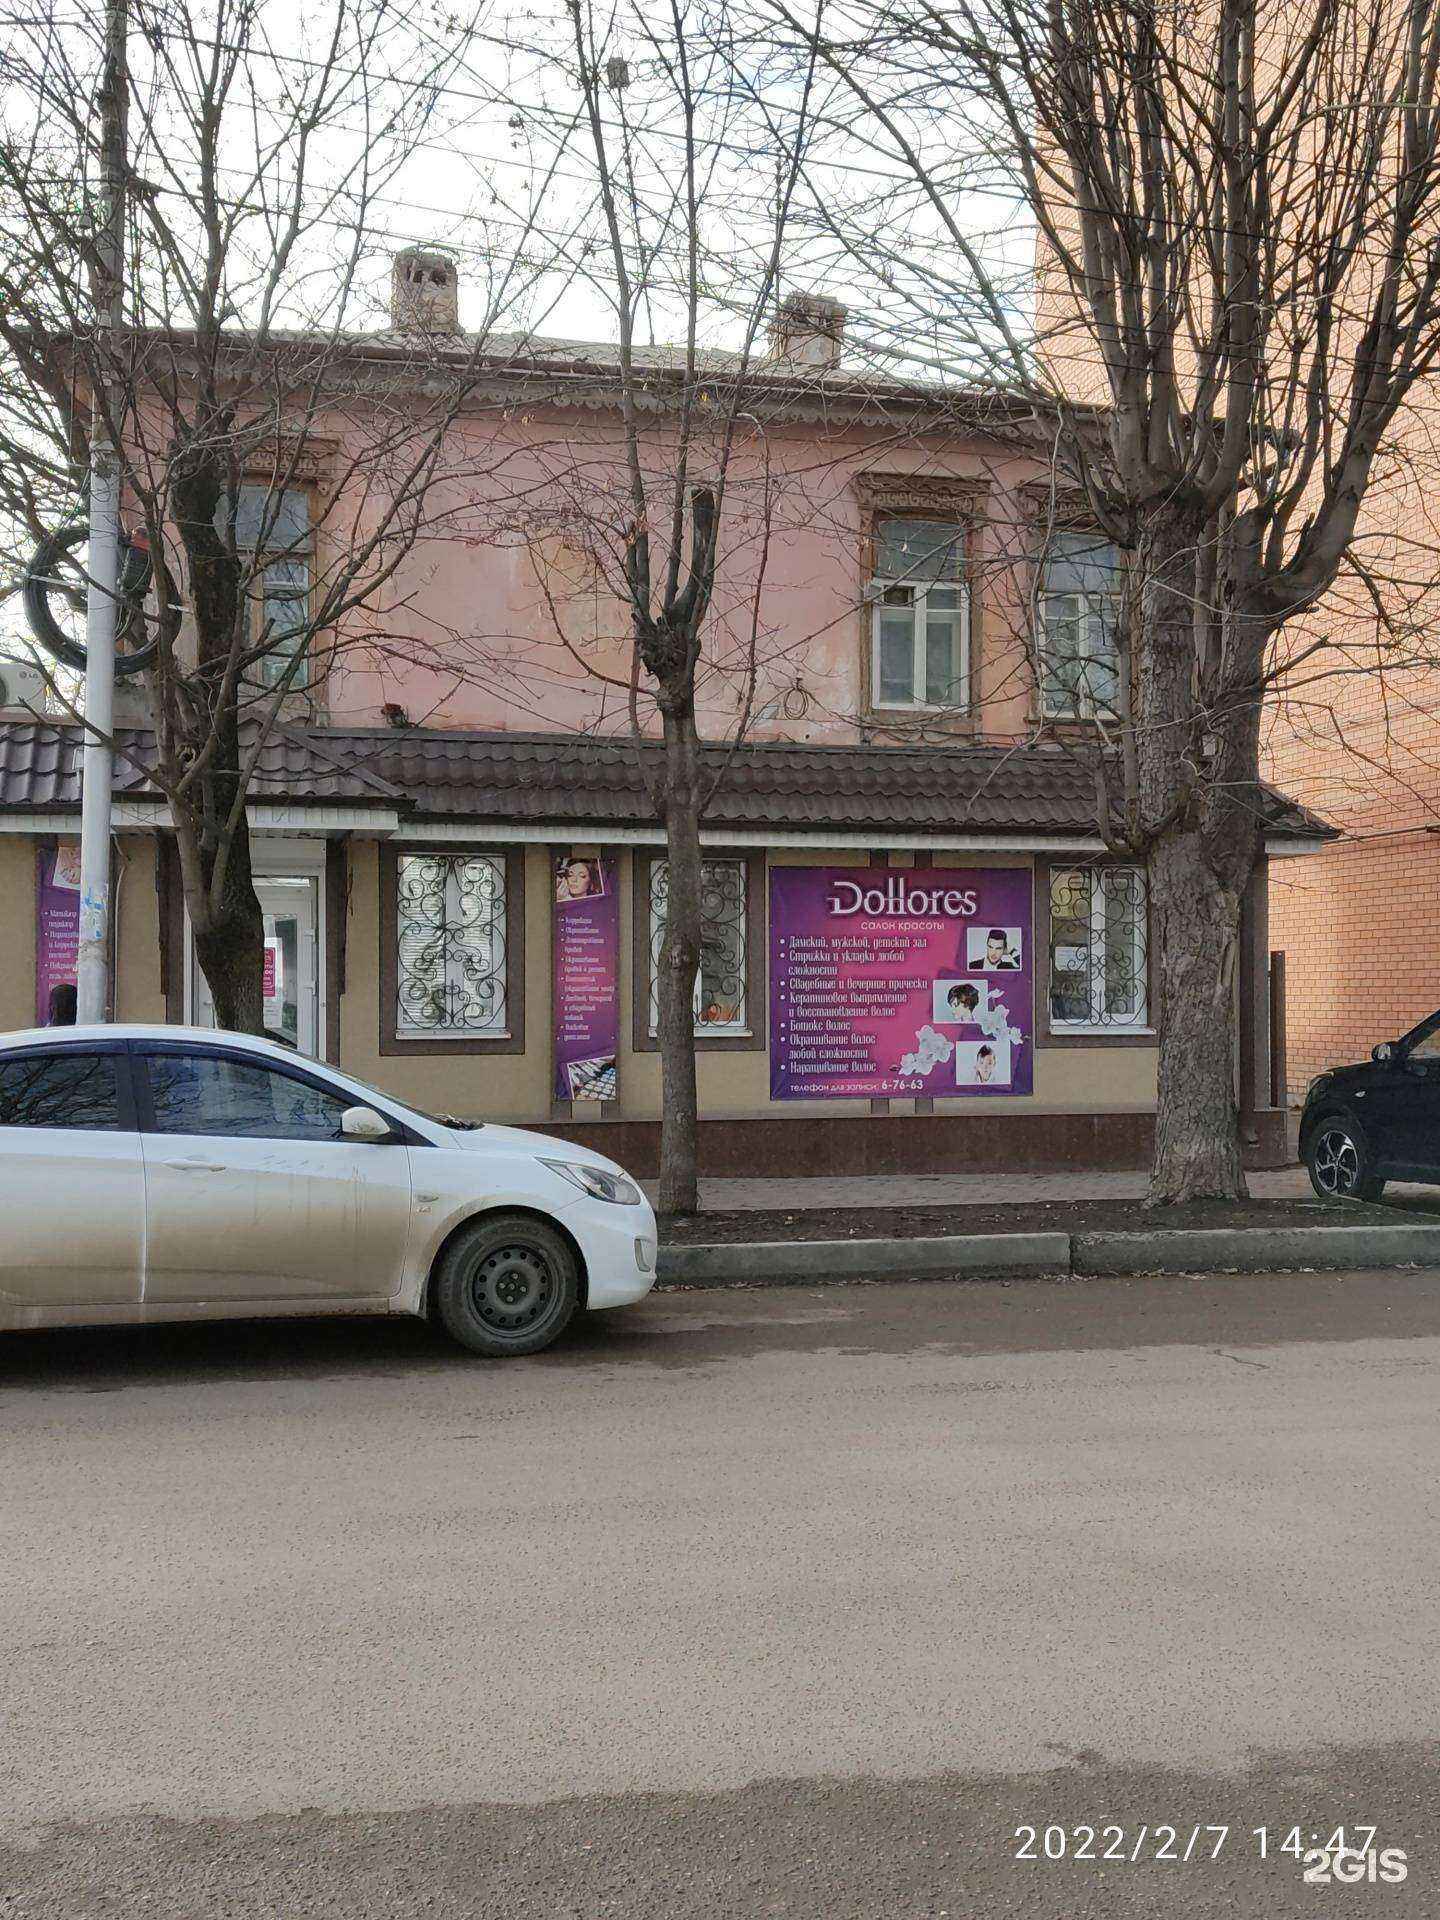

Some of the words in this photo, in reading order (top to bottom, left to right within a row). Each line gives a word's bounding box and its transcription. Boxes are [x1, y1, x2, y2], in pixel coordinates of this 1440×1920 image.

[825, 877, 977, 915] Dollores
[861, 921, 895, 931] салон
[898, 921, 945, 932] красоты
[789, 936, 829, 948] Дамский,
[831, 936, 871, 950] мужской,
[873, 936, 910, 950] детский
[912, 938, 928, 948] зал
[789, 949, 830, 963] Стрижки
[833, 952, 839, 961] и
[841, 950, 875, 964] укладки
[877, 949, 905, 961] любой
[788, 964, 838, 975] сложности
[789, 978, 836, 992] Свадебные
[839, 981, 845, 989] и
[889, 979, 928, 991] прически
[790, 992, 848, 1004] Кератиновое
[850, 992, 907, 1005] выпрямление
[789, 1009, 795, 1018] и
[797, 1006, 868, 1017] восстановление
[871, 1006, 895, 1016] волос
[790, 1020, 824, 1031] Ботокс
[826, 1020, 851, 1031] волос
[790, 1034, 848, 1047] Окрашивание
[851, 1034, 876, 1045] волос
[789, 1047, 816, 1060] любой
[819, 1049, 868, 1060] сложности
[790, 1062, 850, 1075] Наращивание
[852, 1062, 877, 1073] волос
[790, 1083, 829, 1094] телефон
[831, 1084, 844, 1092] для
[881, 1080, 924, 1091] 6-76-63
